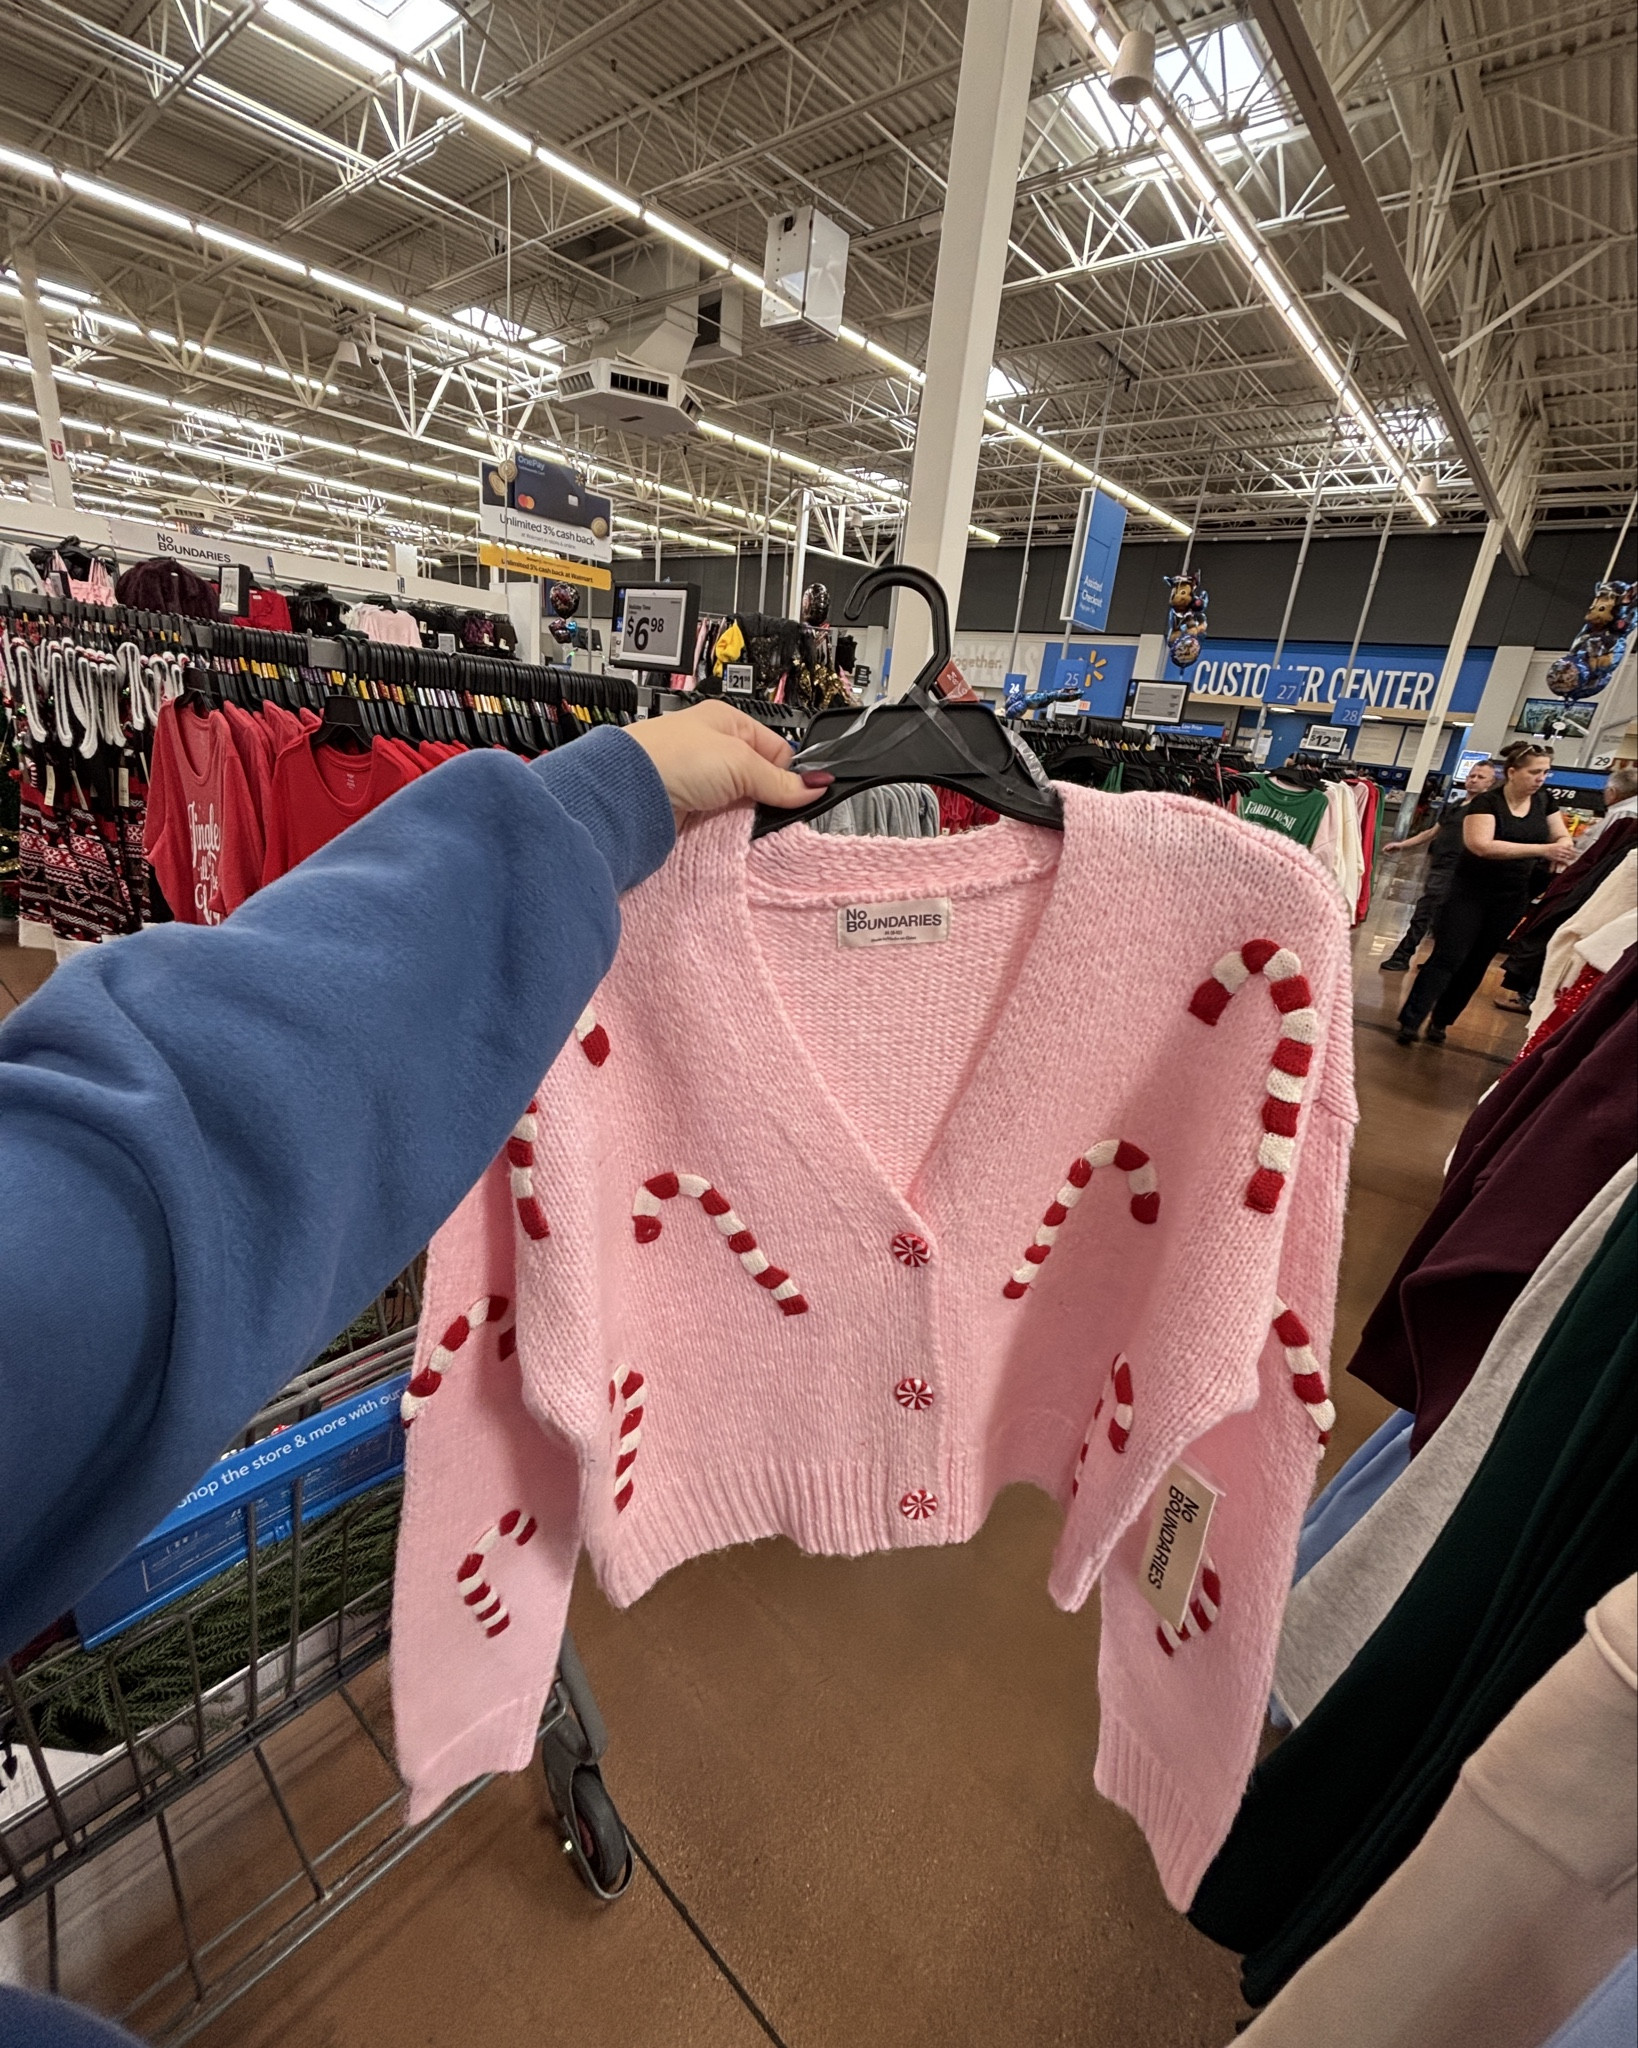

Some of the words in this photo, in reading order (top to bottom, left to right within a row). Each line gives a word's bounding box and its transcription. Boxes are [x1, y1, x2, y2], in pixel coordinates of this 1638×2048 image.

[518, 456, 546, 471] OnePay
[500, 513, 541, 534] Unlimited
[543, 525, 555, 537] 3%
[556, 530, 575, 541] cash
[576, 533, 595, 546] back
[952, 655, 1002, 671] ogether.
[1064, 672, 1079, 687] 25
[1008, 682, 1020, 694] 24
[1276, 684, 1297, 700] 27
[1327, 667, 1435, 711] CENTER
[1341, 709, 1358, 722] 28
[1594, 756, 1611, 767] 29
[220, 1465, 250, 1486] the
[252, 1443, 293, 1470] store
[294, 1433, 308, 1449] &
[308, 1416, 348, 1442] more
[347, 1400, 379, 1422] with
